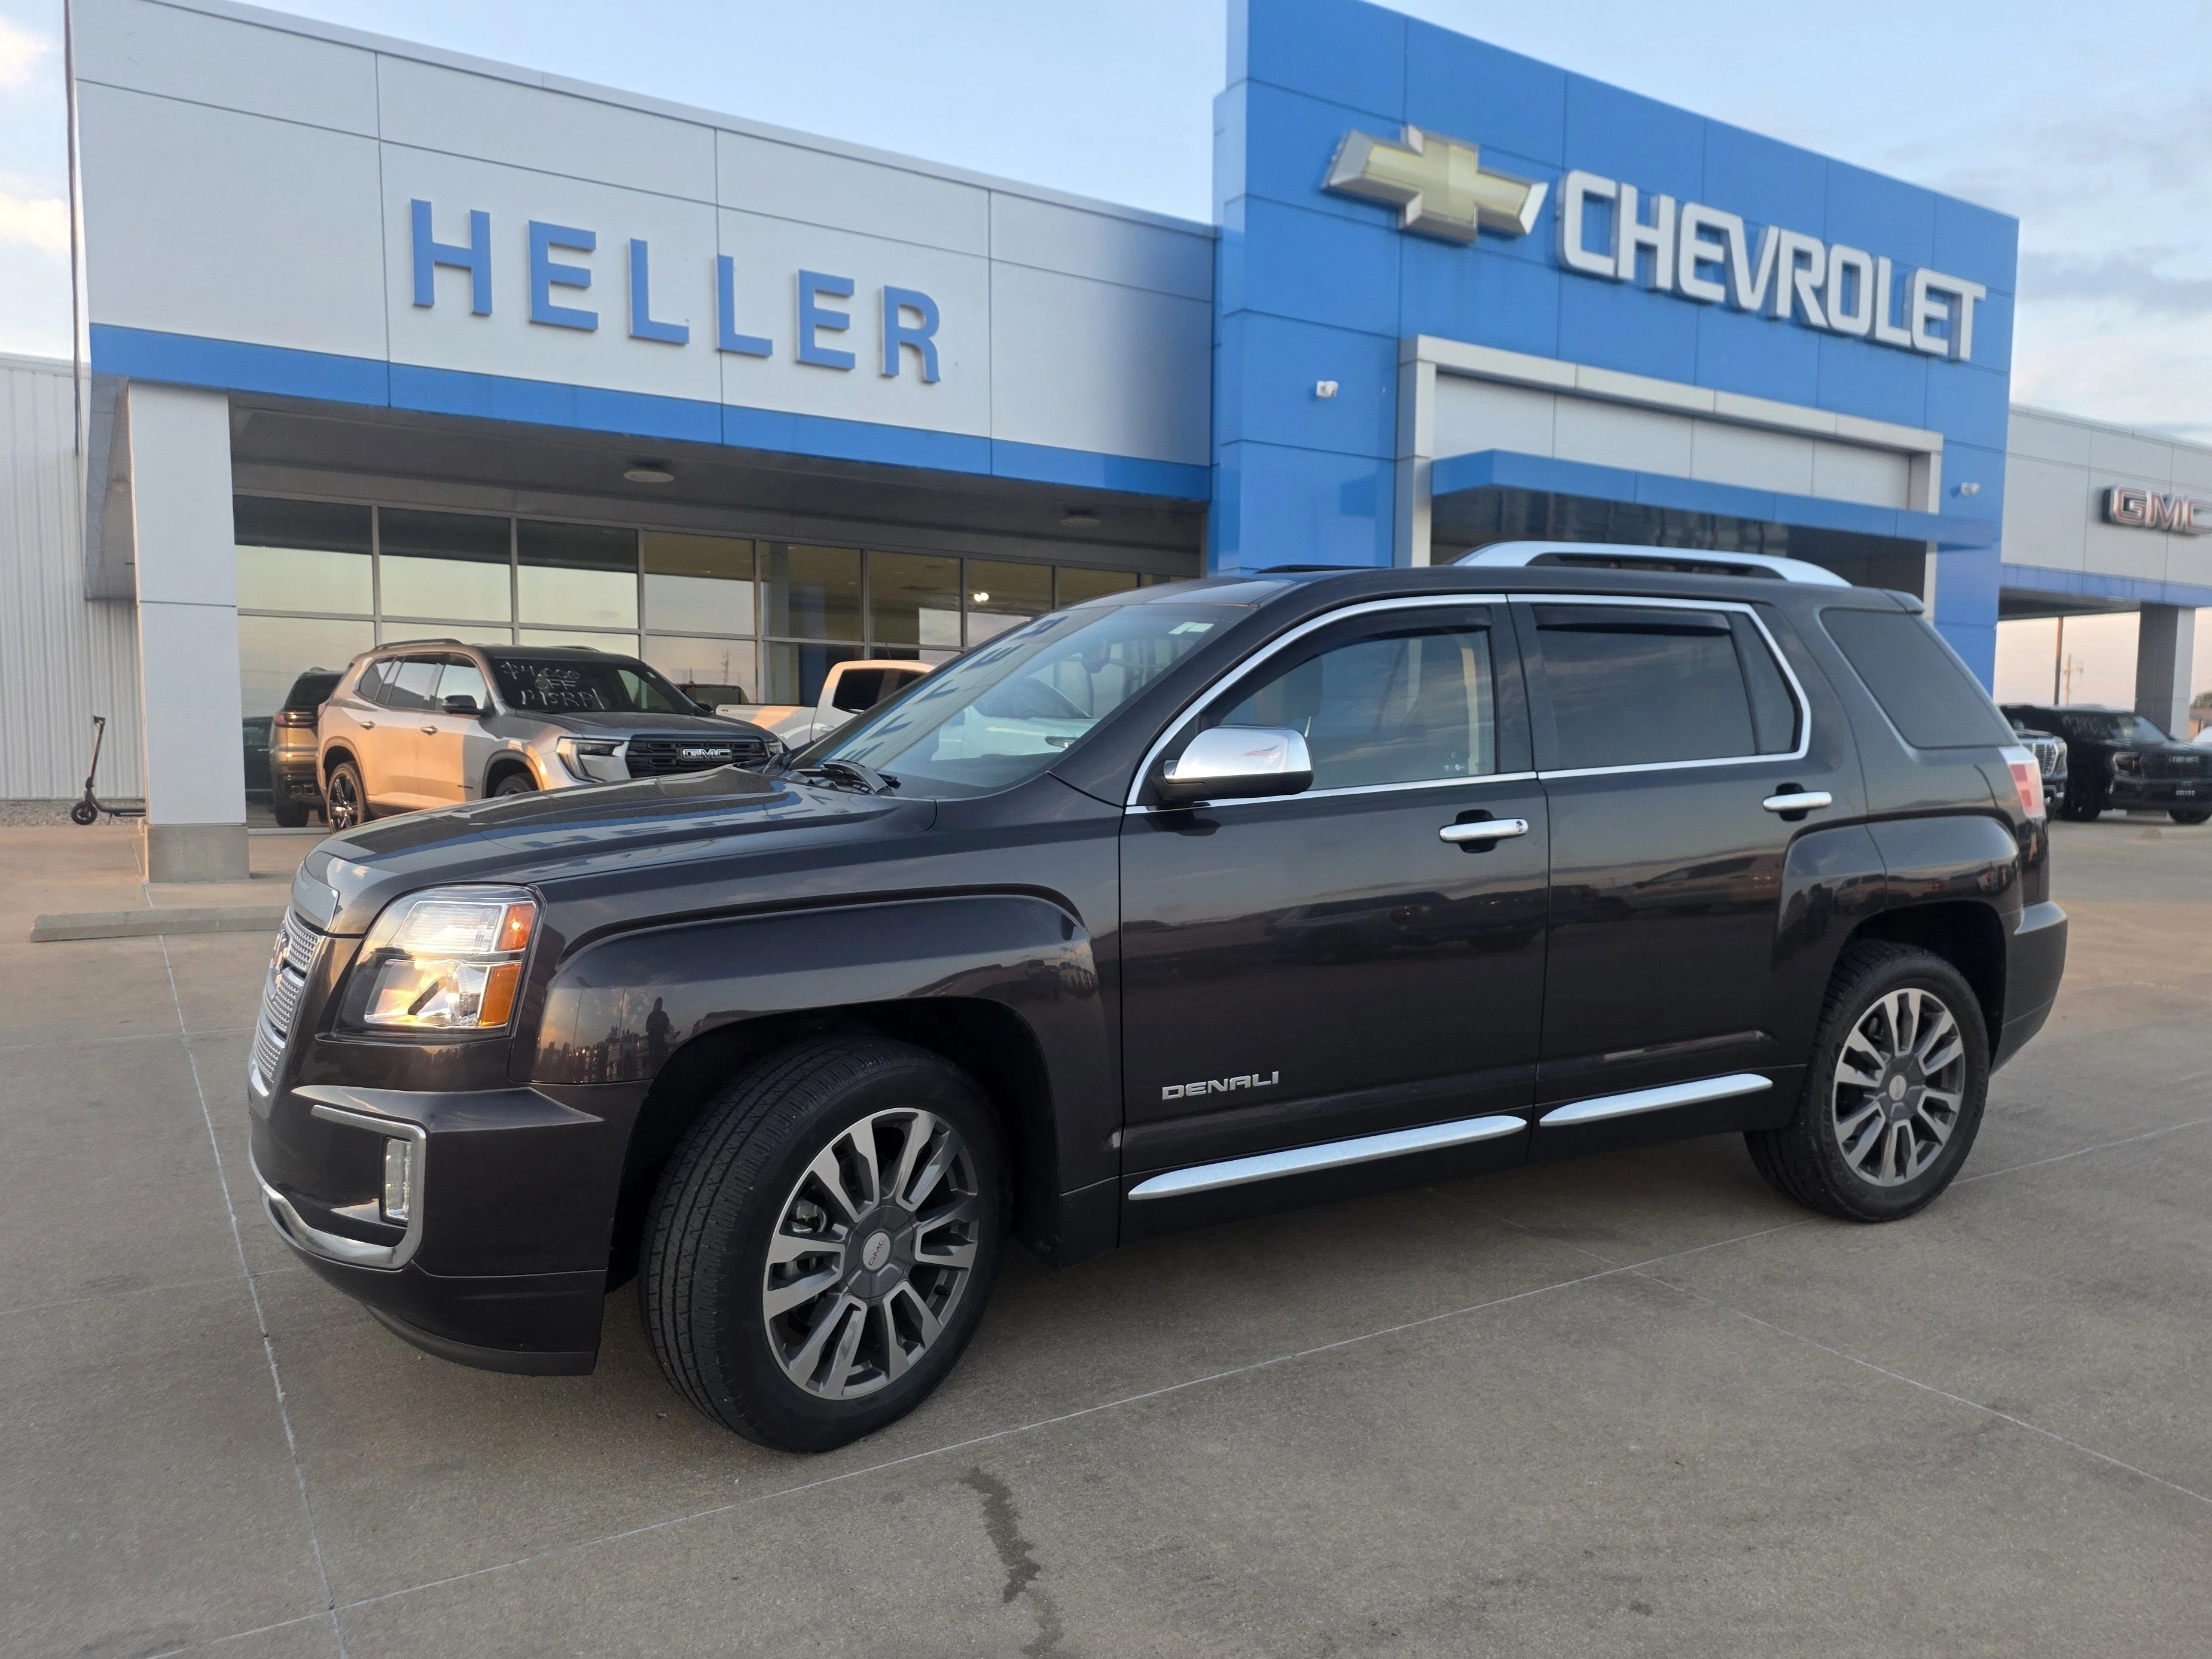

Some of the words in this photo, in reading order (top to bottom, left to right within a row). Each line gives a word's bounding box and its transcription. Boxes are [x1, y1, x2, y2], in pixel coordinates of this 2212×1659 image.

[1560, 170, 1987, 361] CHEVROLET
[410, 199, 941, 383] HELLER
[2109, 485, 2212, 534] GMC
[535, 679, 576, 690] OFF
[682, 748, 732, 760] GMC
[1161, 1071, 1279, 1100] DENALI
[868, 1235, 886, 1266] GMC
